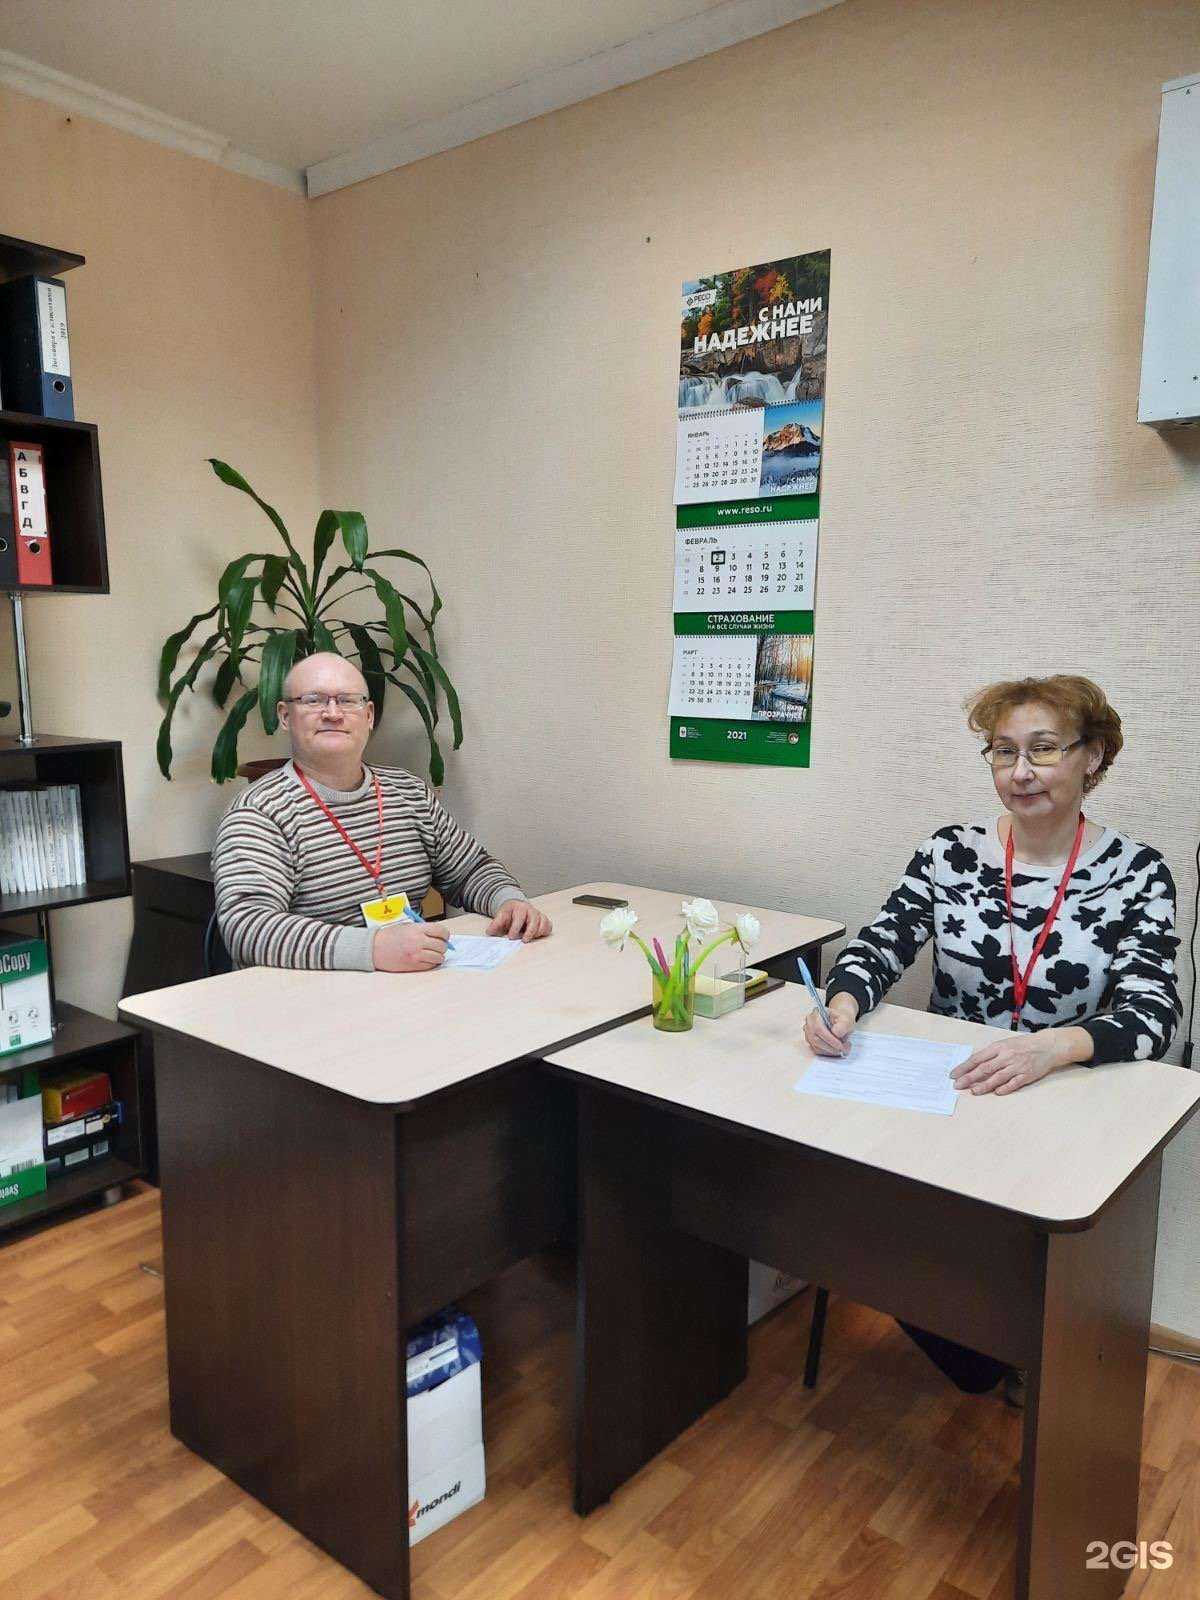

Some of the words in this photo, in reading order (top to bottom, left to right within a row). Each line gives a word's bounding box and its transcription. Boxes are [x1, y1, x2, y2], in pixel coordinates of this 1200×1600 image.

[758, 307, 768, 322] С
[773, 297, 822, 319] НАМИ
[694, 314, 813, 354] НАДЕЖНЕЕ
[17, 452, 26, 461] А
[20, 468, 27, 477] Б
[21, 485, 29, 494] В
[22, 501, 28, 510] Г
[717, 504, 772, 516] www.reso.ru
[23, 517, 32, 528] Д
[708, 615, 775, 623] СТРАХОВАНИЕ
[727, 731, 747, 739] 2021
[0, 952, 31, 974] Copy
[416, 1481, 462, 1519] mondi
